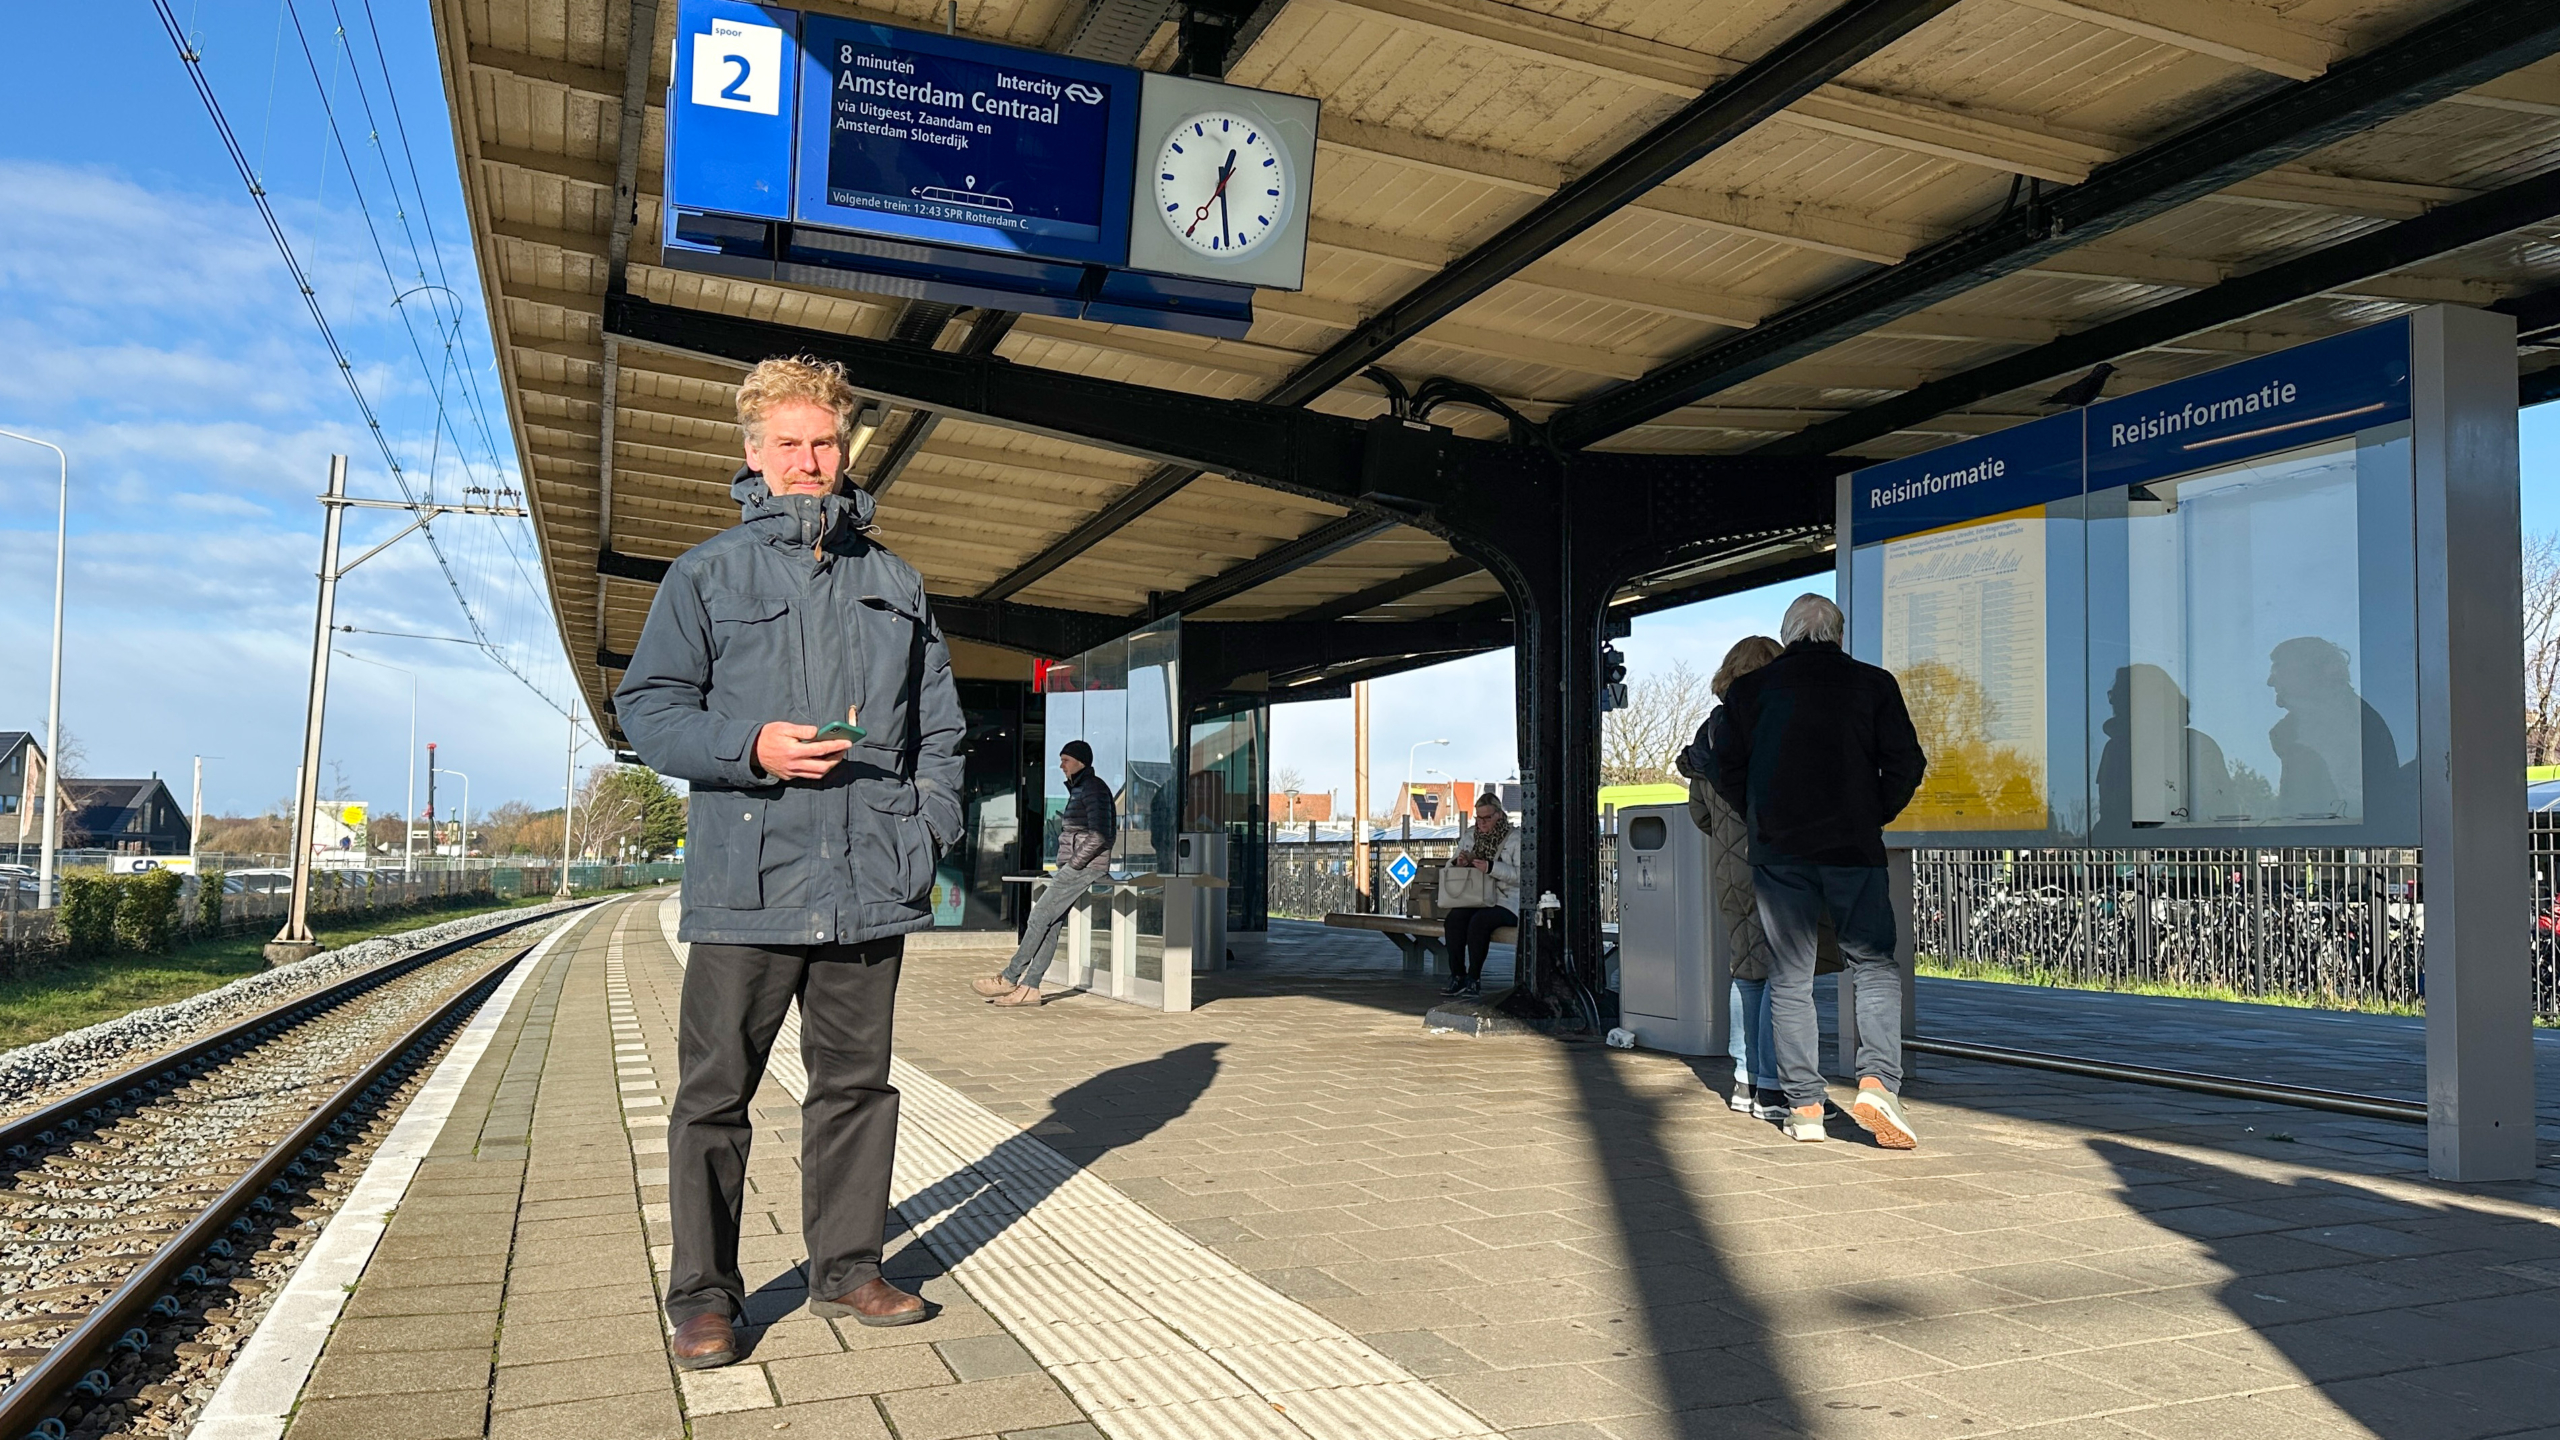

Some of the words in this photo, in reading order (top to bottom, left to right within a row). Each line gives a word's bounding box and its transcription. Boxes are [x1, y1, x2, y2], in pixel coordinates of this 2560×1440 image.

[715, 27, 742, 37] spoor
[840, 45, 852, 64] 8
[856, 53, 915, 75] minuten
[720, 54, 751, 103] 2
[997, 73, 1061, 100] Intercity
[838, 70, 964, 109] Amsterdam
[971, 91, 1059, 125] Centraal
[836, 117, 907, 140] Amsterdam
[910, 129, 969, 151] Sloterdijk
[837, 101, 856, 113] via
[860, 103, 915, 124] Uitgeest,
[918, 112, 974, 133] Zaandam
[977, 124, 992, 135] en
[833, 191, 881, 209] Volgende
[884, 200, 911, 213] trein:
[914, 204, 941, 217] 12:43
[944, 208, 963, 220] SPR
[965, 211, 1018, 228] Rotterdam
[1019, 219, 1029, 230] C.
[2111, 381, 2297, 448] Reisinformatie
[1870, 457, 2005, 509] Reisinformatie
[1397, 863, 1410, 878] 4
